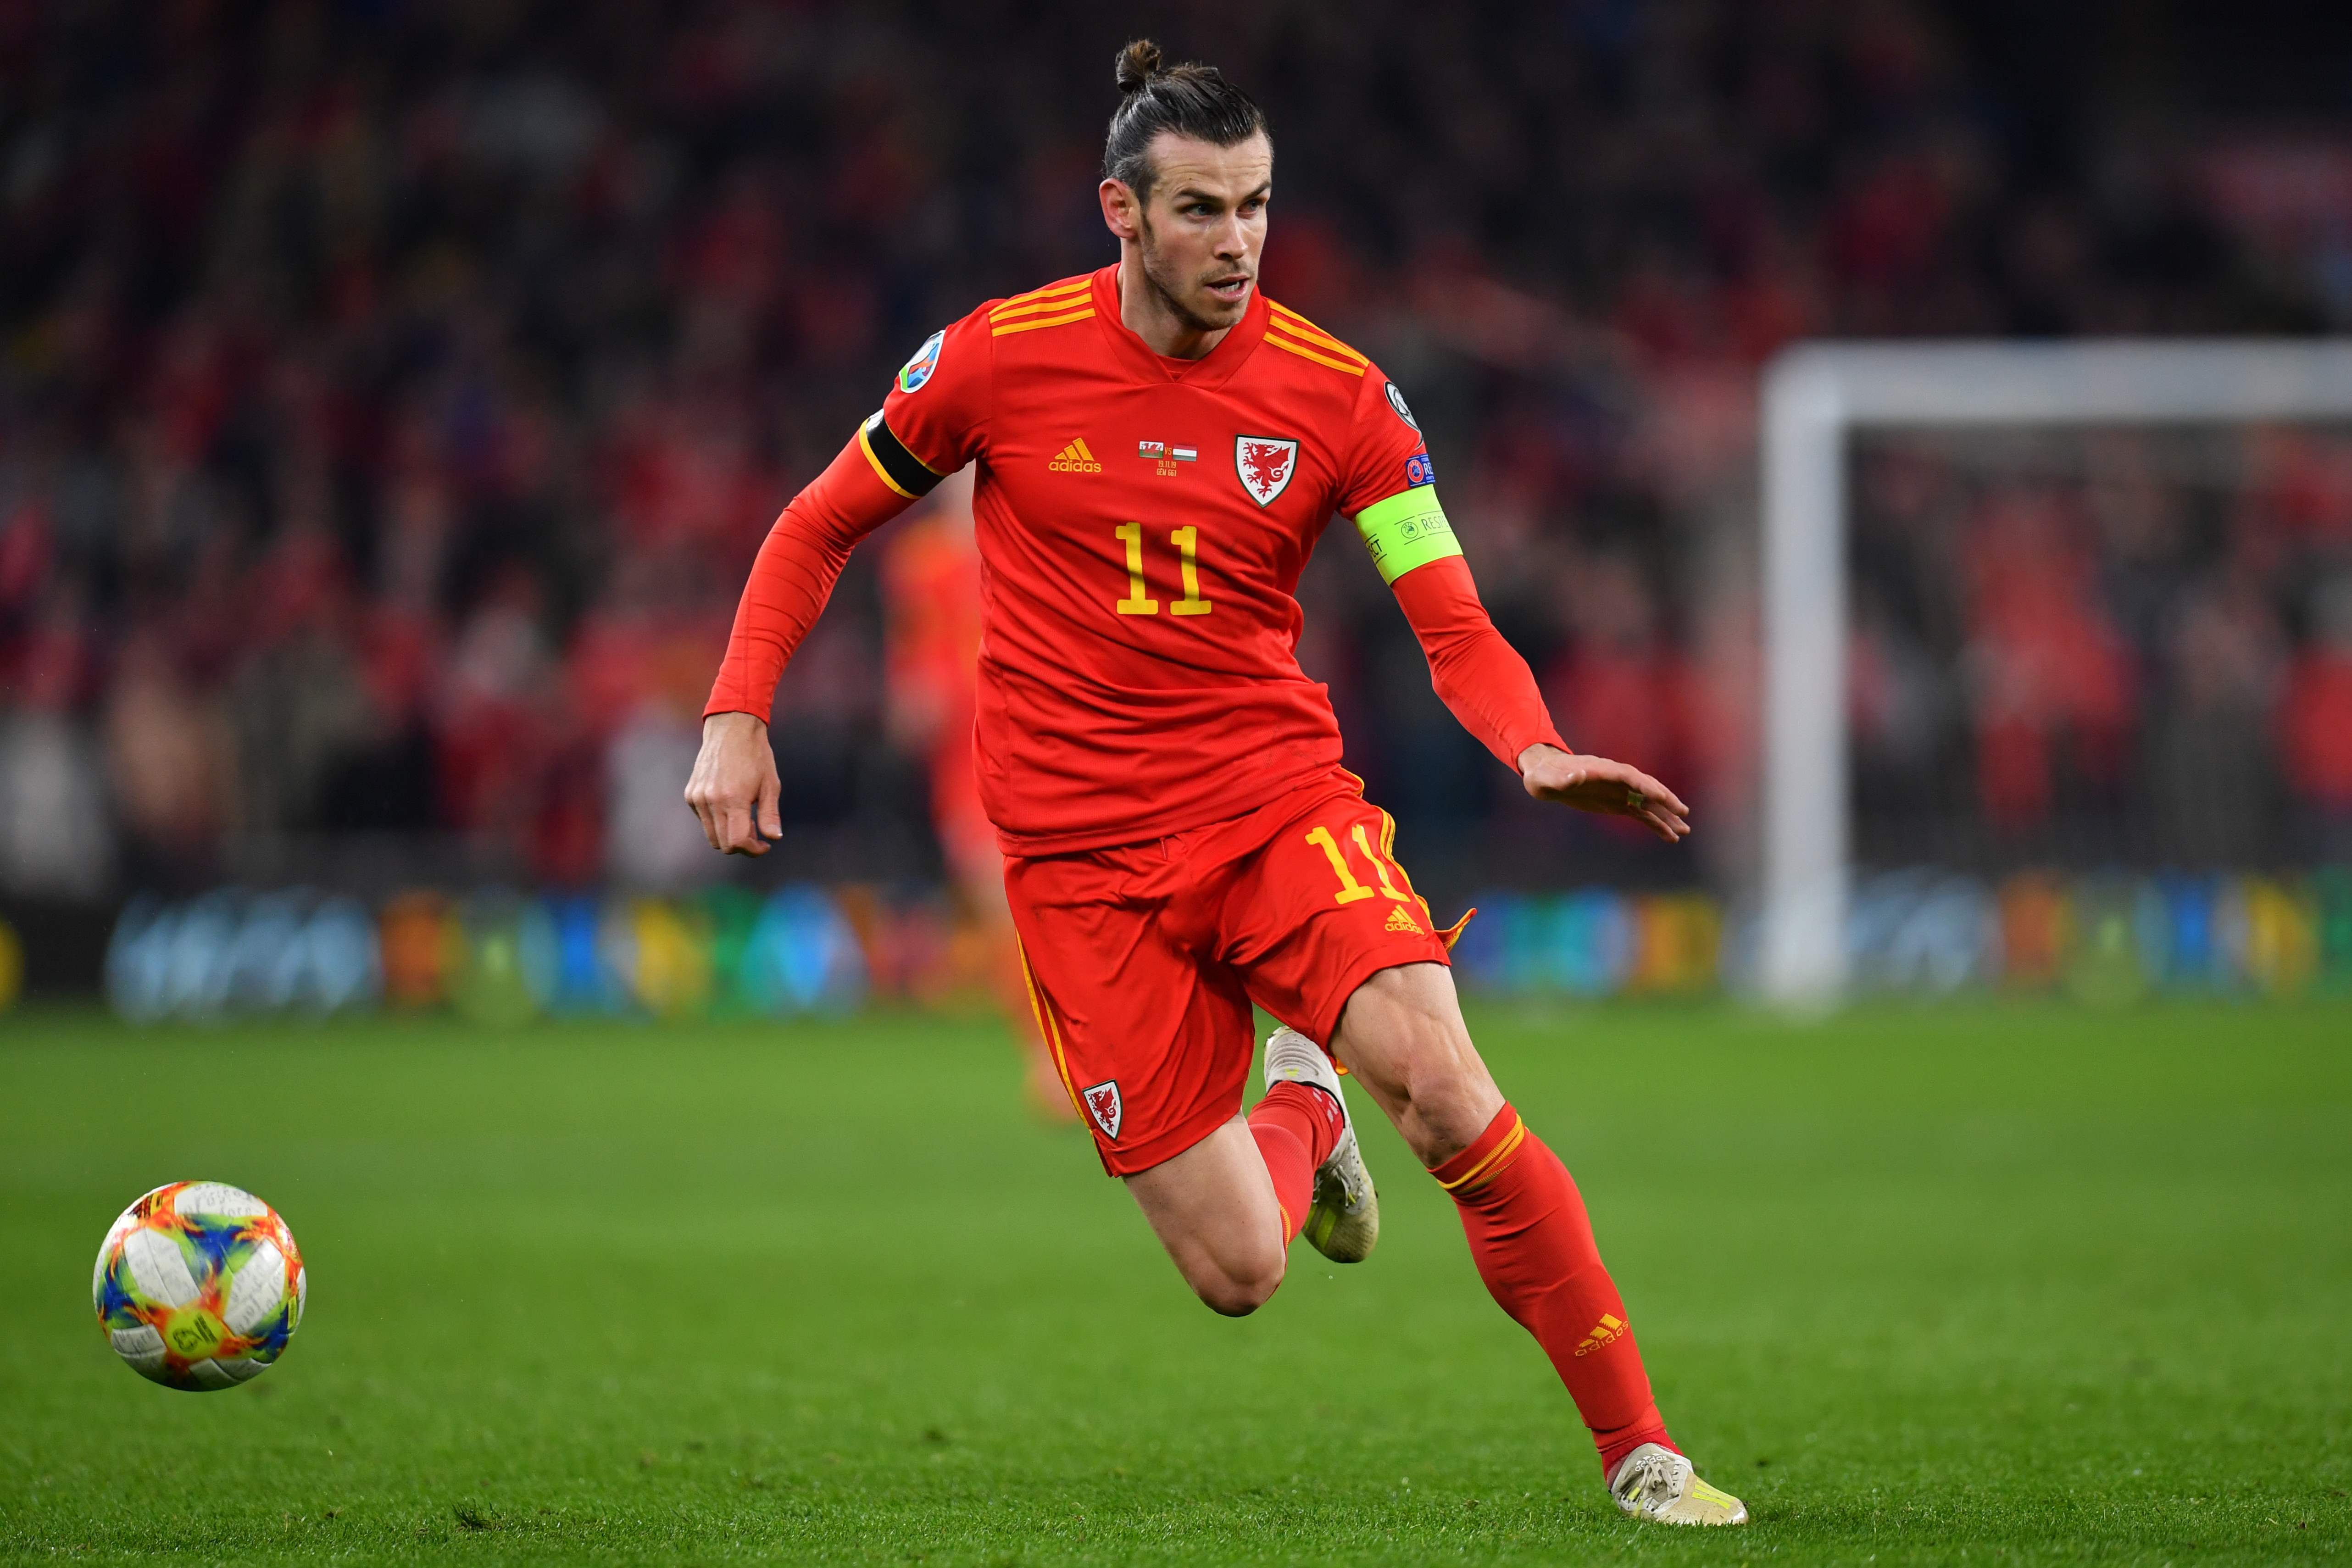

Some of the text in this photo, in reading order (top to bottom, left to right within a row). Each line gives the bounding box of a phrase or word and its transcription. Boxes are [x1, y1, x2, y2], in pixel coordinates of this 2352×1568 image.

[1049, 460, 1101, 473] adidas
[1115, 522, 1212, 615] 11
[1305, 824, 1411, 904] 11
[1385, 922, 1424, 935] adidas
[1575, 1321, 1629, 1357] adidas
